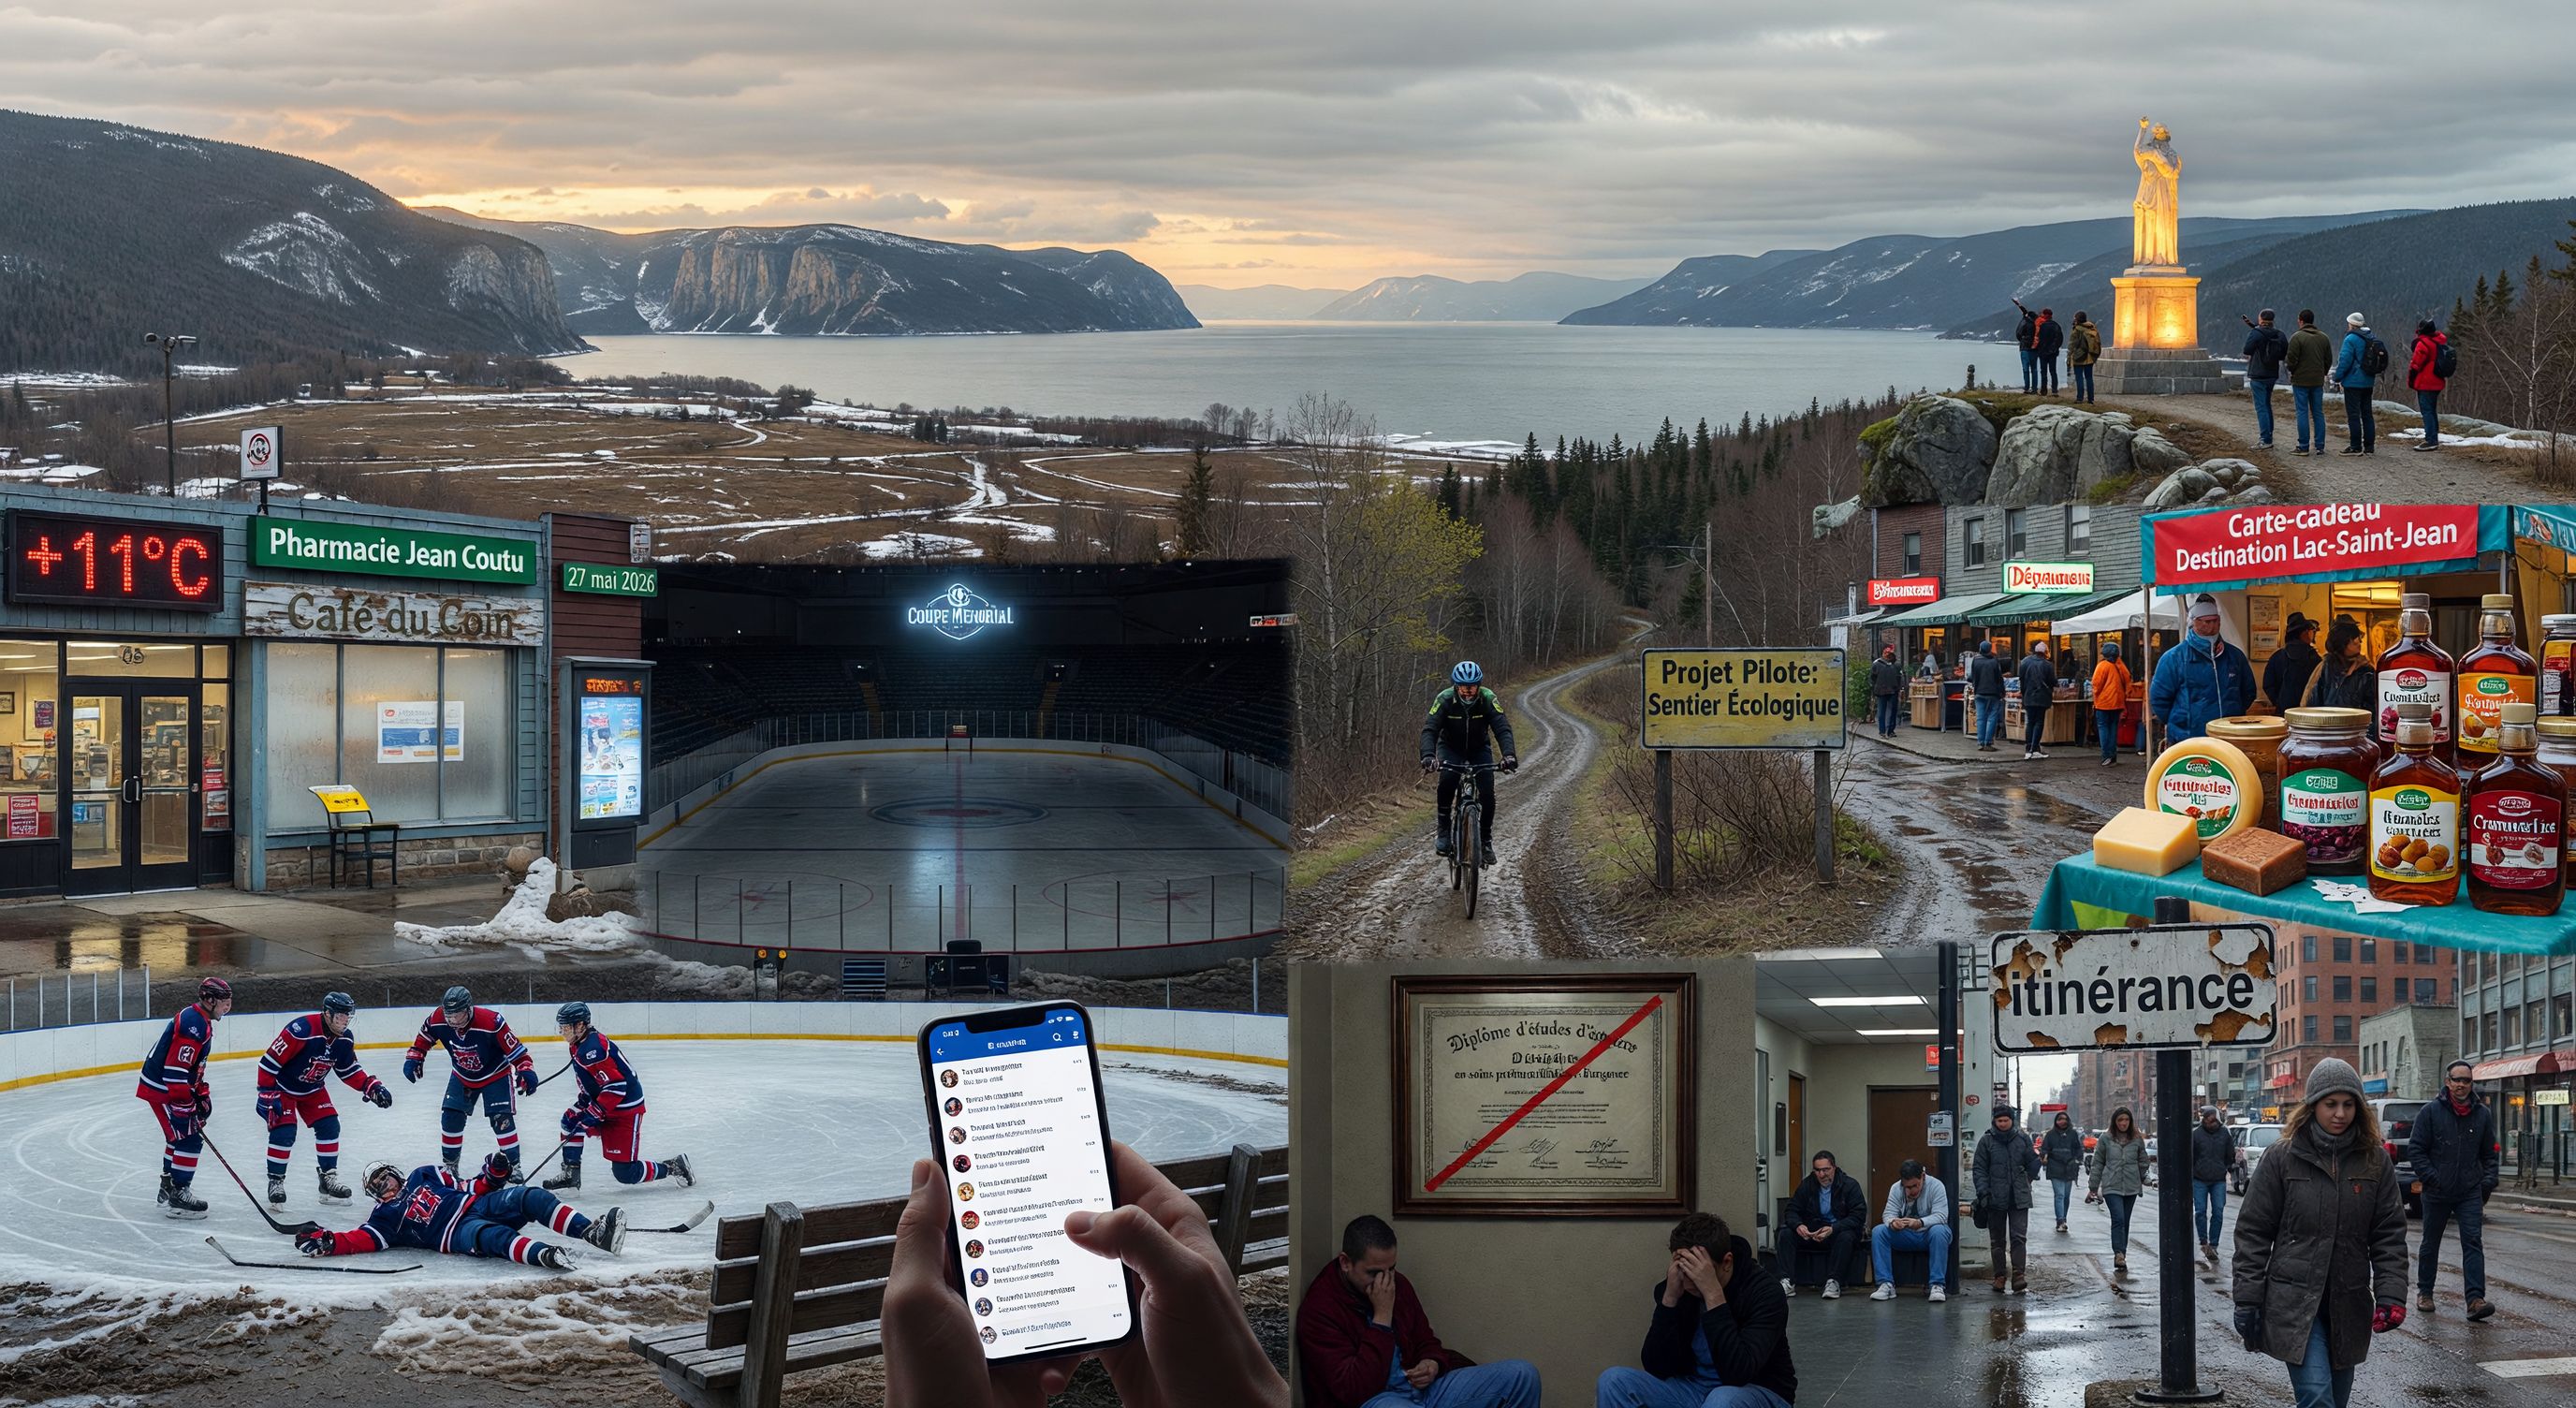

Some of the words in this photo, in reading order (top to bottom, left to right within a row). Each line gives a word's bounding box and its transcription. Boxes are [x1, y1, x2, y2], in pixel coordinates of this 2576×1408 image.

[2228, 504, 2381, 538] Carte-cadeau
[270, 527, 401, 564] Pharmacie
[405, 540, 457, 568] Jean
[461, 544, 524, 573] Coutu
[2176, 540, 2287, 572] Destination
[2292, 521, 2458, 561] Lac-Saint-Jean
[568, 566, 586, 588] 27
[591, 569, 618, 590] mai
[622, 570, 655, 593] 2026
[287, 592, 373, 634] Café
[386, 596, 431, 637] du
[438, 598, 515, 639] Coin
[1661, 659, 1734, 690] Projet
[1743, 658, 1818, 684] Pilote:
[1648, 692, 1720, 716] Sentier
[1728, 688, 1839, 721] Écologique
[2012, 965, 2254, 1017] itinérance
[1446, 1027, 1511, 1054] Diplôme
